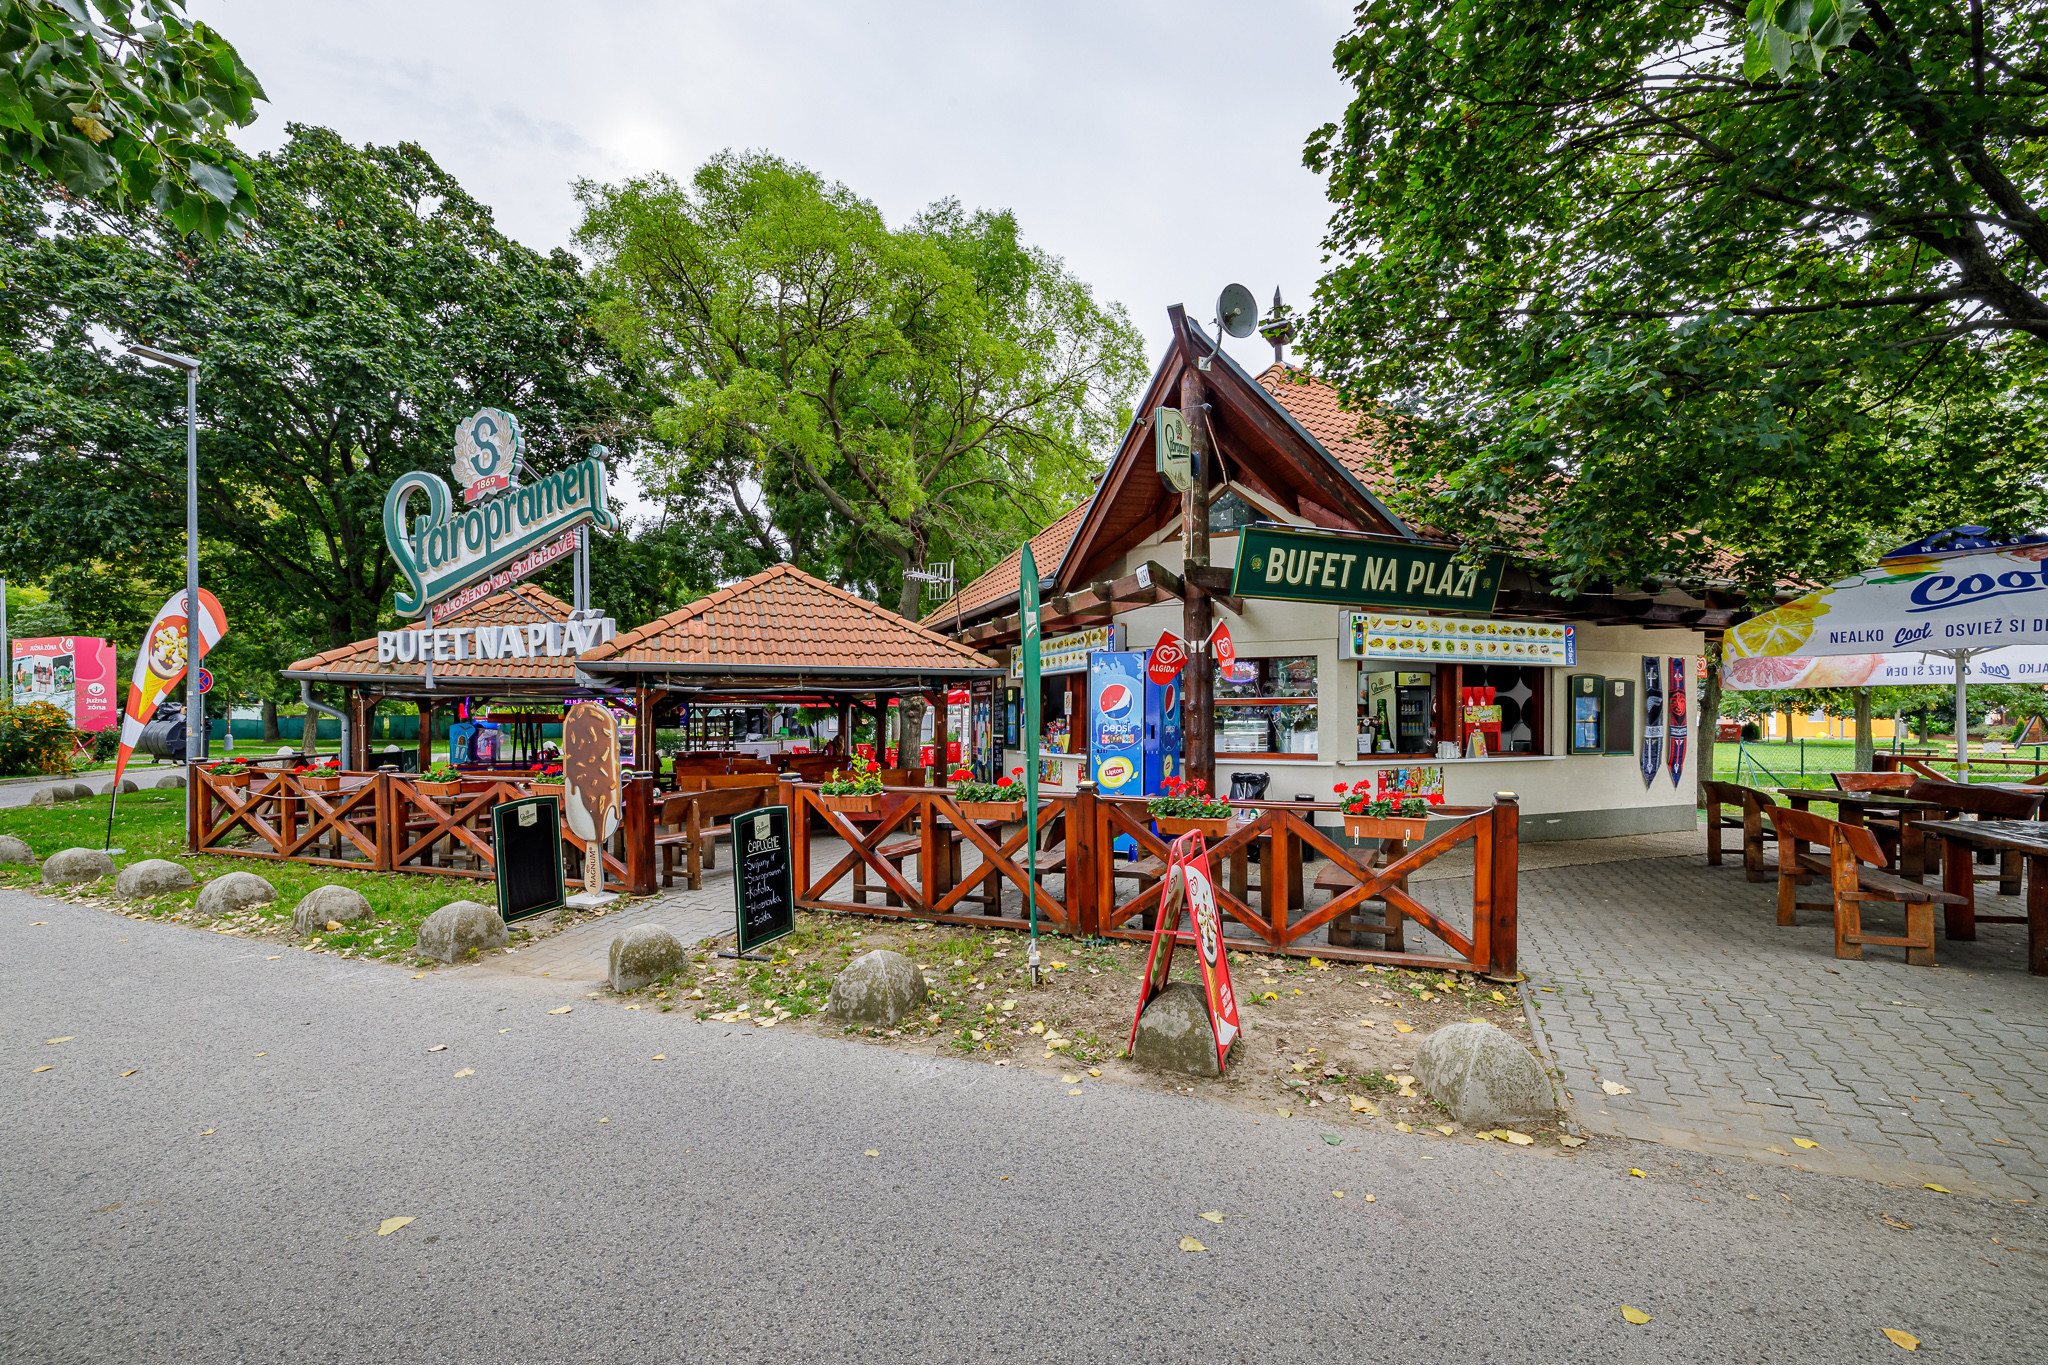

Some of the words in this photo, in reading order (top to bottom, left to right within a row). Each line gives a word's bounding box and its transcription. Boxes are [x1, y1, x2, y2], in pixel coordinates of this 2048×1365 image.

[476, 476, 496, 491] 1869
[384, 458, 613, 615] Staropramen
[1920, 537, 2019, 553] NALKO
[434, 581, 491, 621] ZALOŽENO
[492, 570, 512, 591] NA
[511, 533, 574, 579] SMÍCHOVĚ
[1265, 547, 1357, 589] BUFET
[1361, 556, 1398, 592] NA
[378, 627, 472, 663] BUFET
[476, 626, 525, 660] NA
[528, 608, 616, 657] PLÁŽI
[1829, 629, 1885, 644] NEALKO
[1892, 621, 1934, 648] Cool
[1945, 617, 2003, 638] OSVIEŽ
[2009, 618, 2026, 633] SI
[1566, 639, 1575, 665] pepsi
[1149, 663, 1176, 673] ALGIDA
[87, 703, 107, 711] zóna
[1101, 721, 1131, 734] pepsi
[1106, 767, 1123, 776] Lipton
